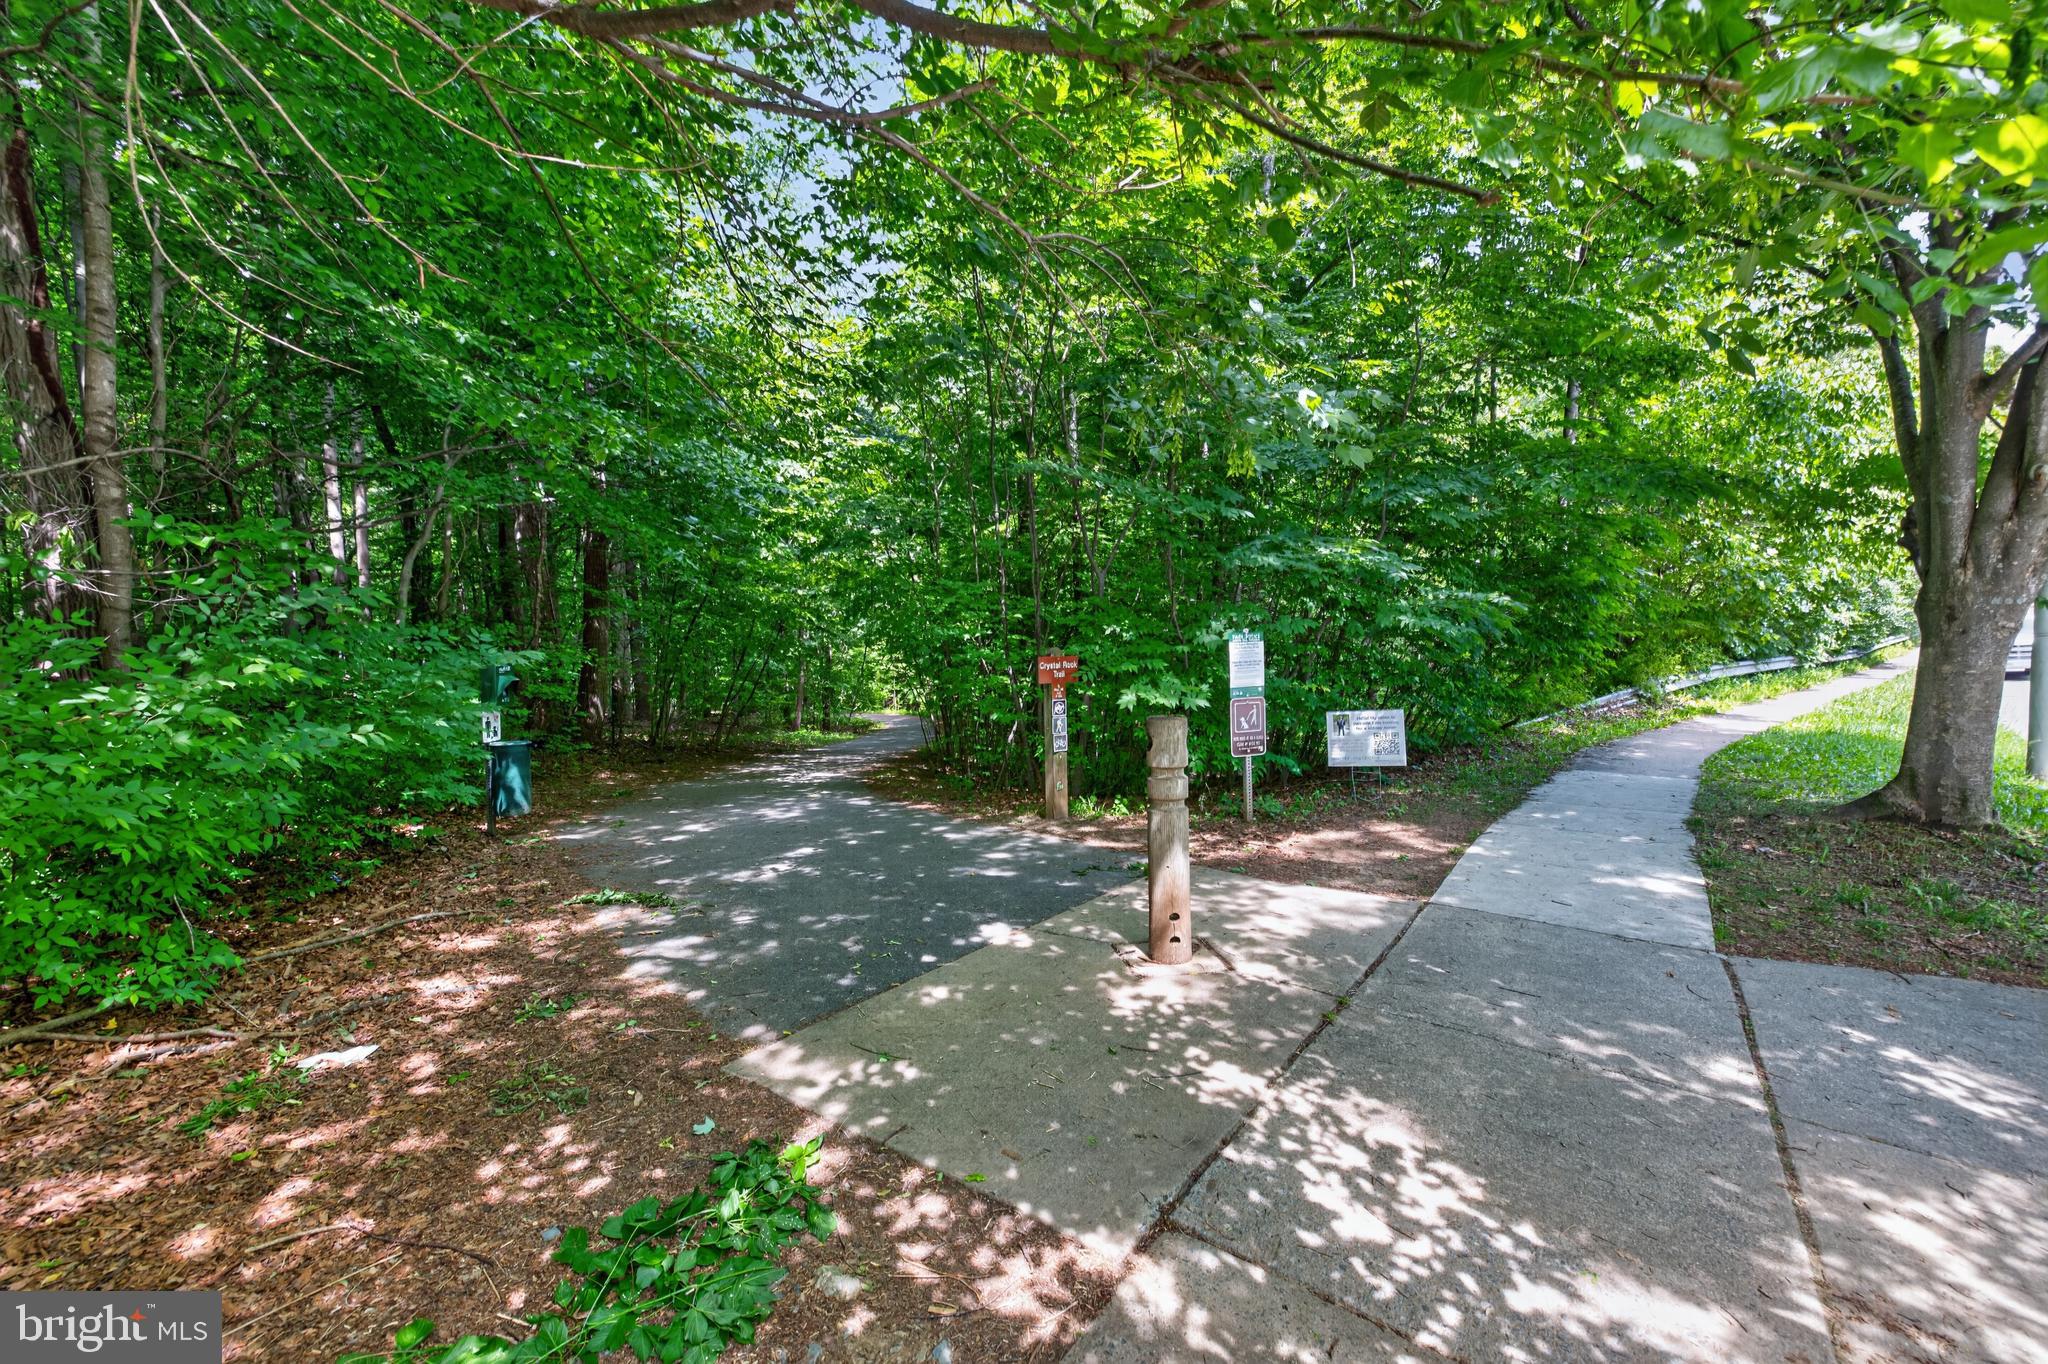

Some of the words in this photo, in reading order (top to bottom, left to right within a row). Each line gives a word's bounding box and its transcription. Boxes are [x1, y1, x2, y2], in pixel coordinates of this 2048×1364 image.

[1040, 661, 1061, 671] Crystal
[1062, 660, 1078, 669] Rock
[1053, 670, 1066, 678] Trail
